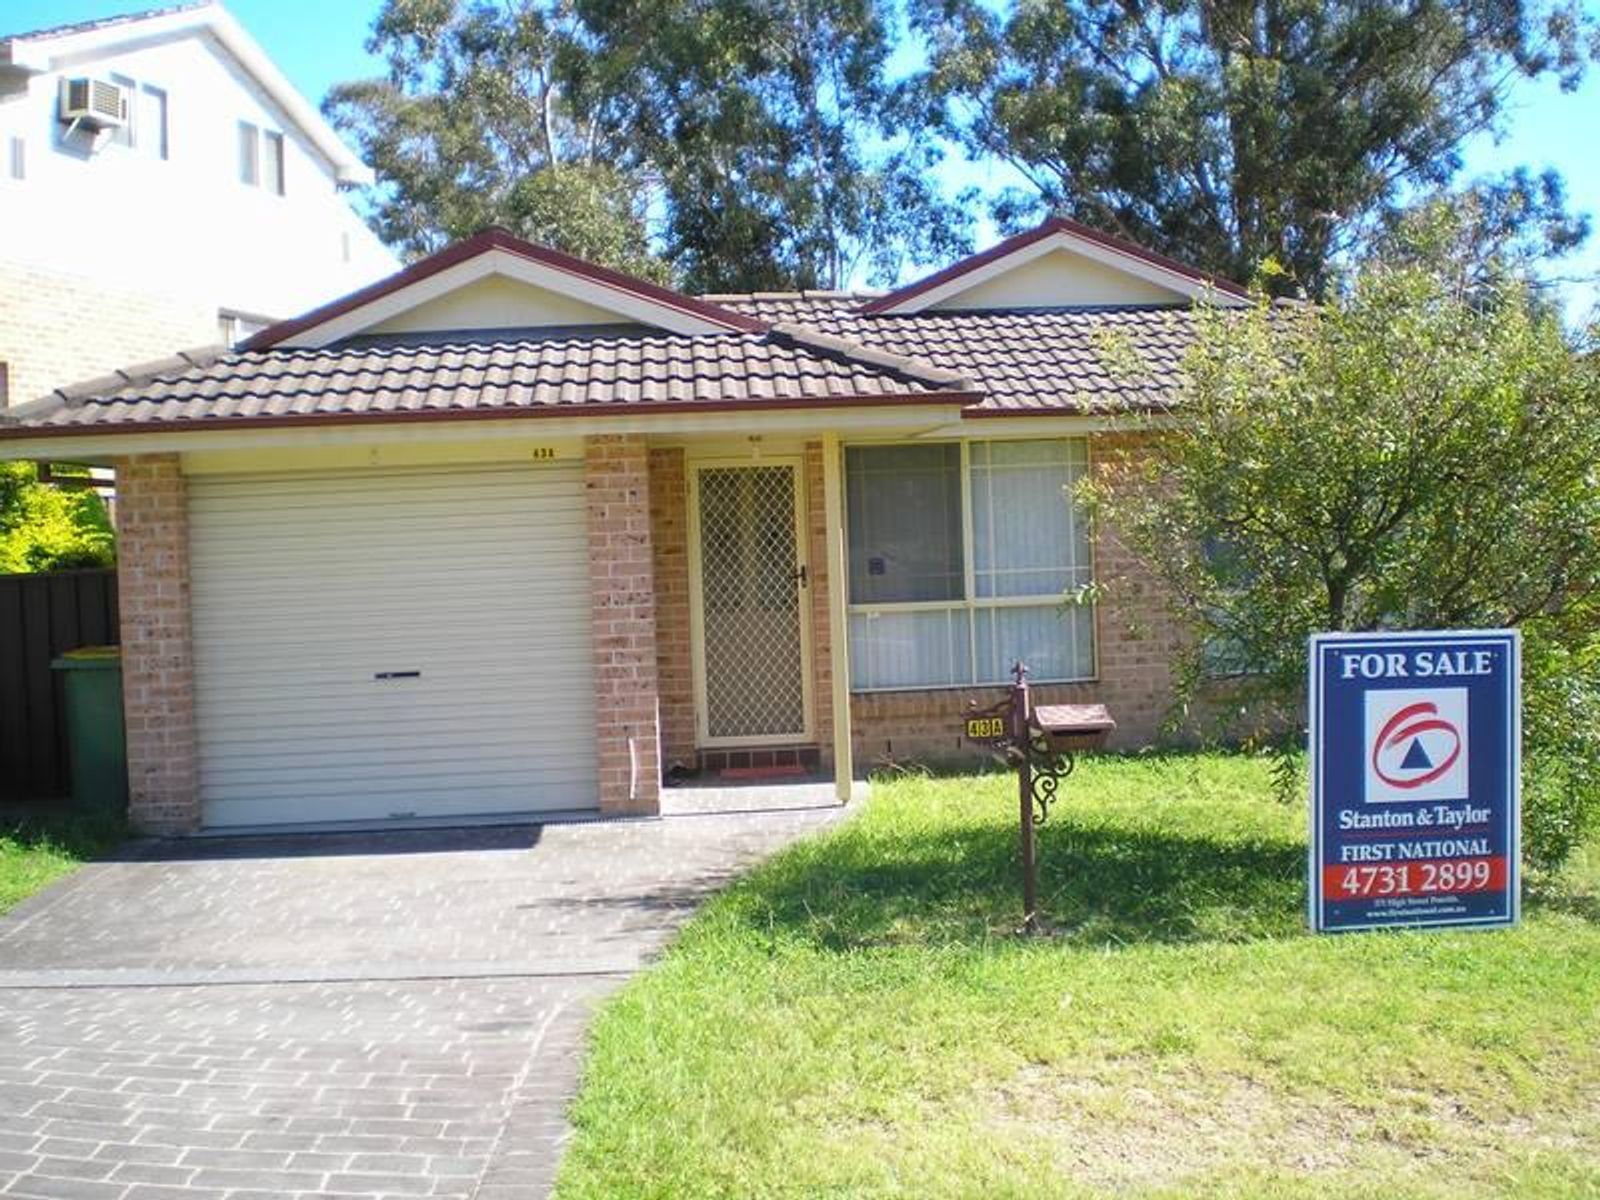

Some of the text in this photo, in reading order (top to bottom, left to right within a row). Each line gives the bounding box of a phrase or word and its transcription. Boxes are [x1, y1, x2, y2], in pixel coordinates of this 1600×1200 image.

[1342, 650, 1492, 678] FOR SALE
[969, 719, 1002, 736] 43A
[1339, 804, 1491, 830] Stanton & Taylor
[1341, 838, 1492, 862] FIRST NATIONAL
[1341, 860, 1490, 895] 4731 2899
